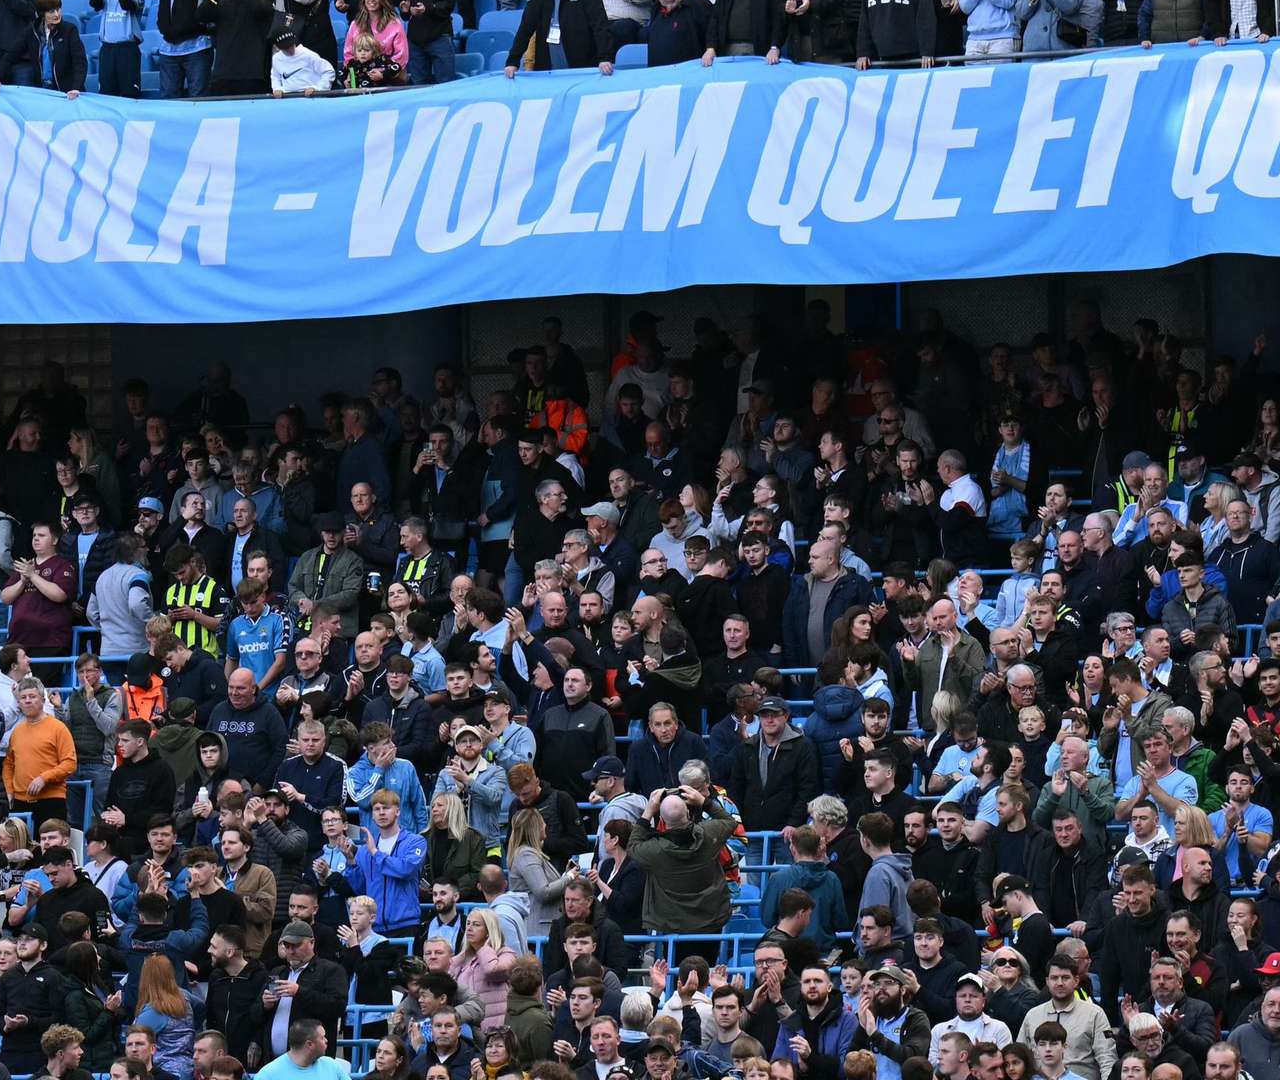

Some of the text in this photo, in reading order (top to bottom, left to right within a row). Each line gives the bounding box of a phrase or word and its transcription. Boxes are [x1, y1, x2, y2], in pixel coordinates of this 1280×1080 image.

[274, 191, 318, 211] -
[349, 80, 748, 259] VOLEM
[748, 66, 995, 245] QUE
[993, 53, 1165, 213] ET
[239, 643, 269, 655] brother
[218, 720, 256, 734] BOSS
